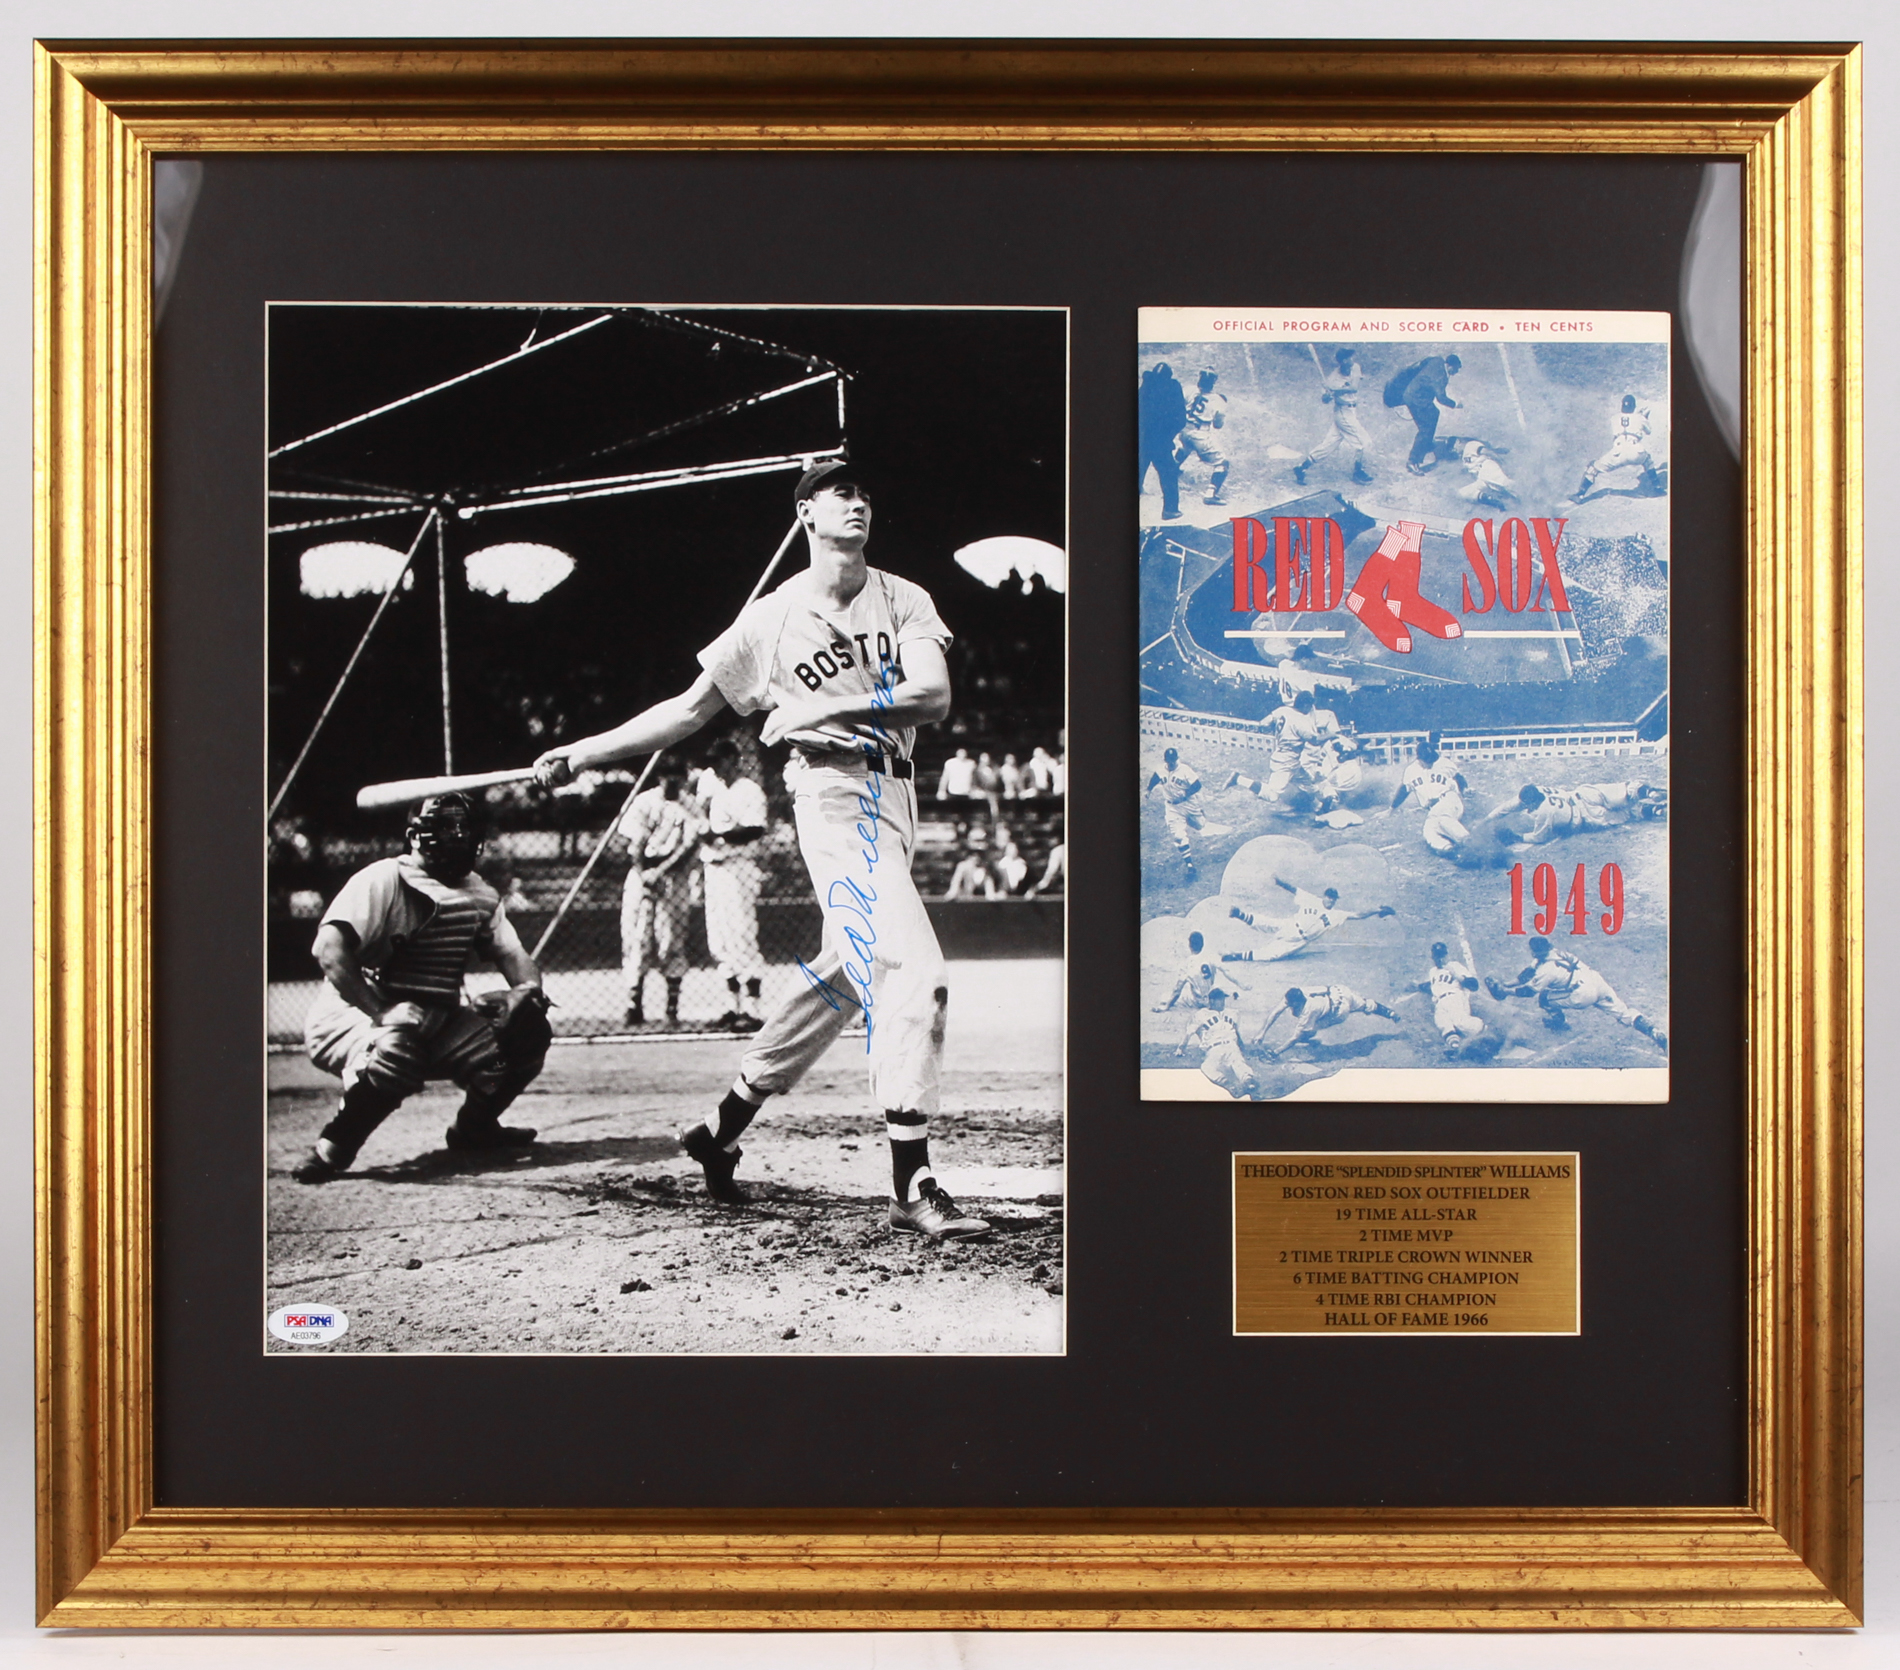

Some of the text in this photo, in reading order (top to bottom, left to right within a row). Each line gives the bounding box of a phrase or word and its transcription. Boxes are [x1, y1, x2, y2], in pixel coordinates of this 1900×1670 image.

[1213, 320, 1594, 333] OFFICIAL PROGRAM AND SCORE CARD TEN CENTS
[1229, 517, 1573, 614] RED SOX
[794, 631, 900, 692] BOSTO
[1506, 862, 1625, 935] 1949
[1241, 1165, 1334, 1178] THEODORE
[1489, 1165, 1571, 1179] WILLIAMS
[1282, 1187, 1530, 1199] BOSTON RED SOX OUTFIELDER
[1336, 1209, 1477, 1221] 19 TIME ALL-STAR
[1359, 1230, 1453, 1242] 2 TIME MVP
[1279, 1251, 1533, 1263] 2 TIME TRIPLE CROWN WINNER
[1293, 1272, 1519, 1285] 6 TIME BATTING CHAMPION
[1315, 1294, 1497, 1306] 4 TIME RBI CHAMPION
[287, 1315, 332, 1326] PSA DNA
[1325, 1313, 1488, 1326] HALL OF FAME 1966
[291, 1332, 321, 1340] AE03796
